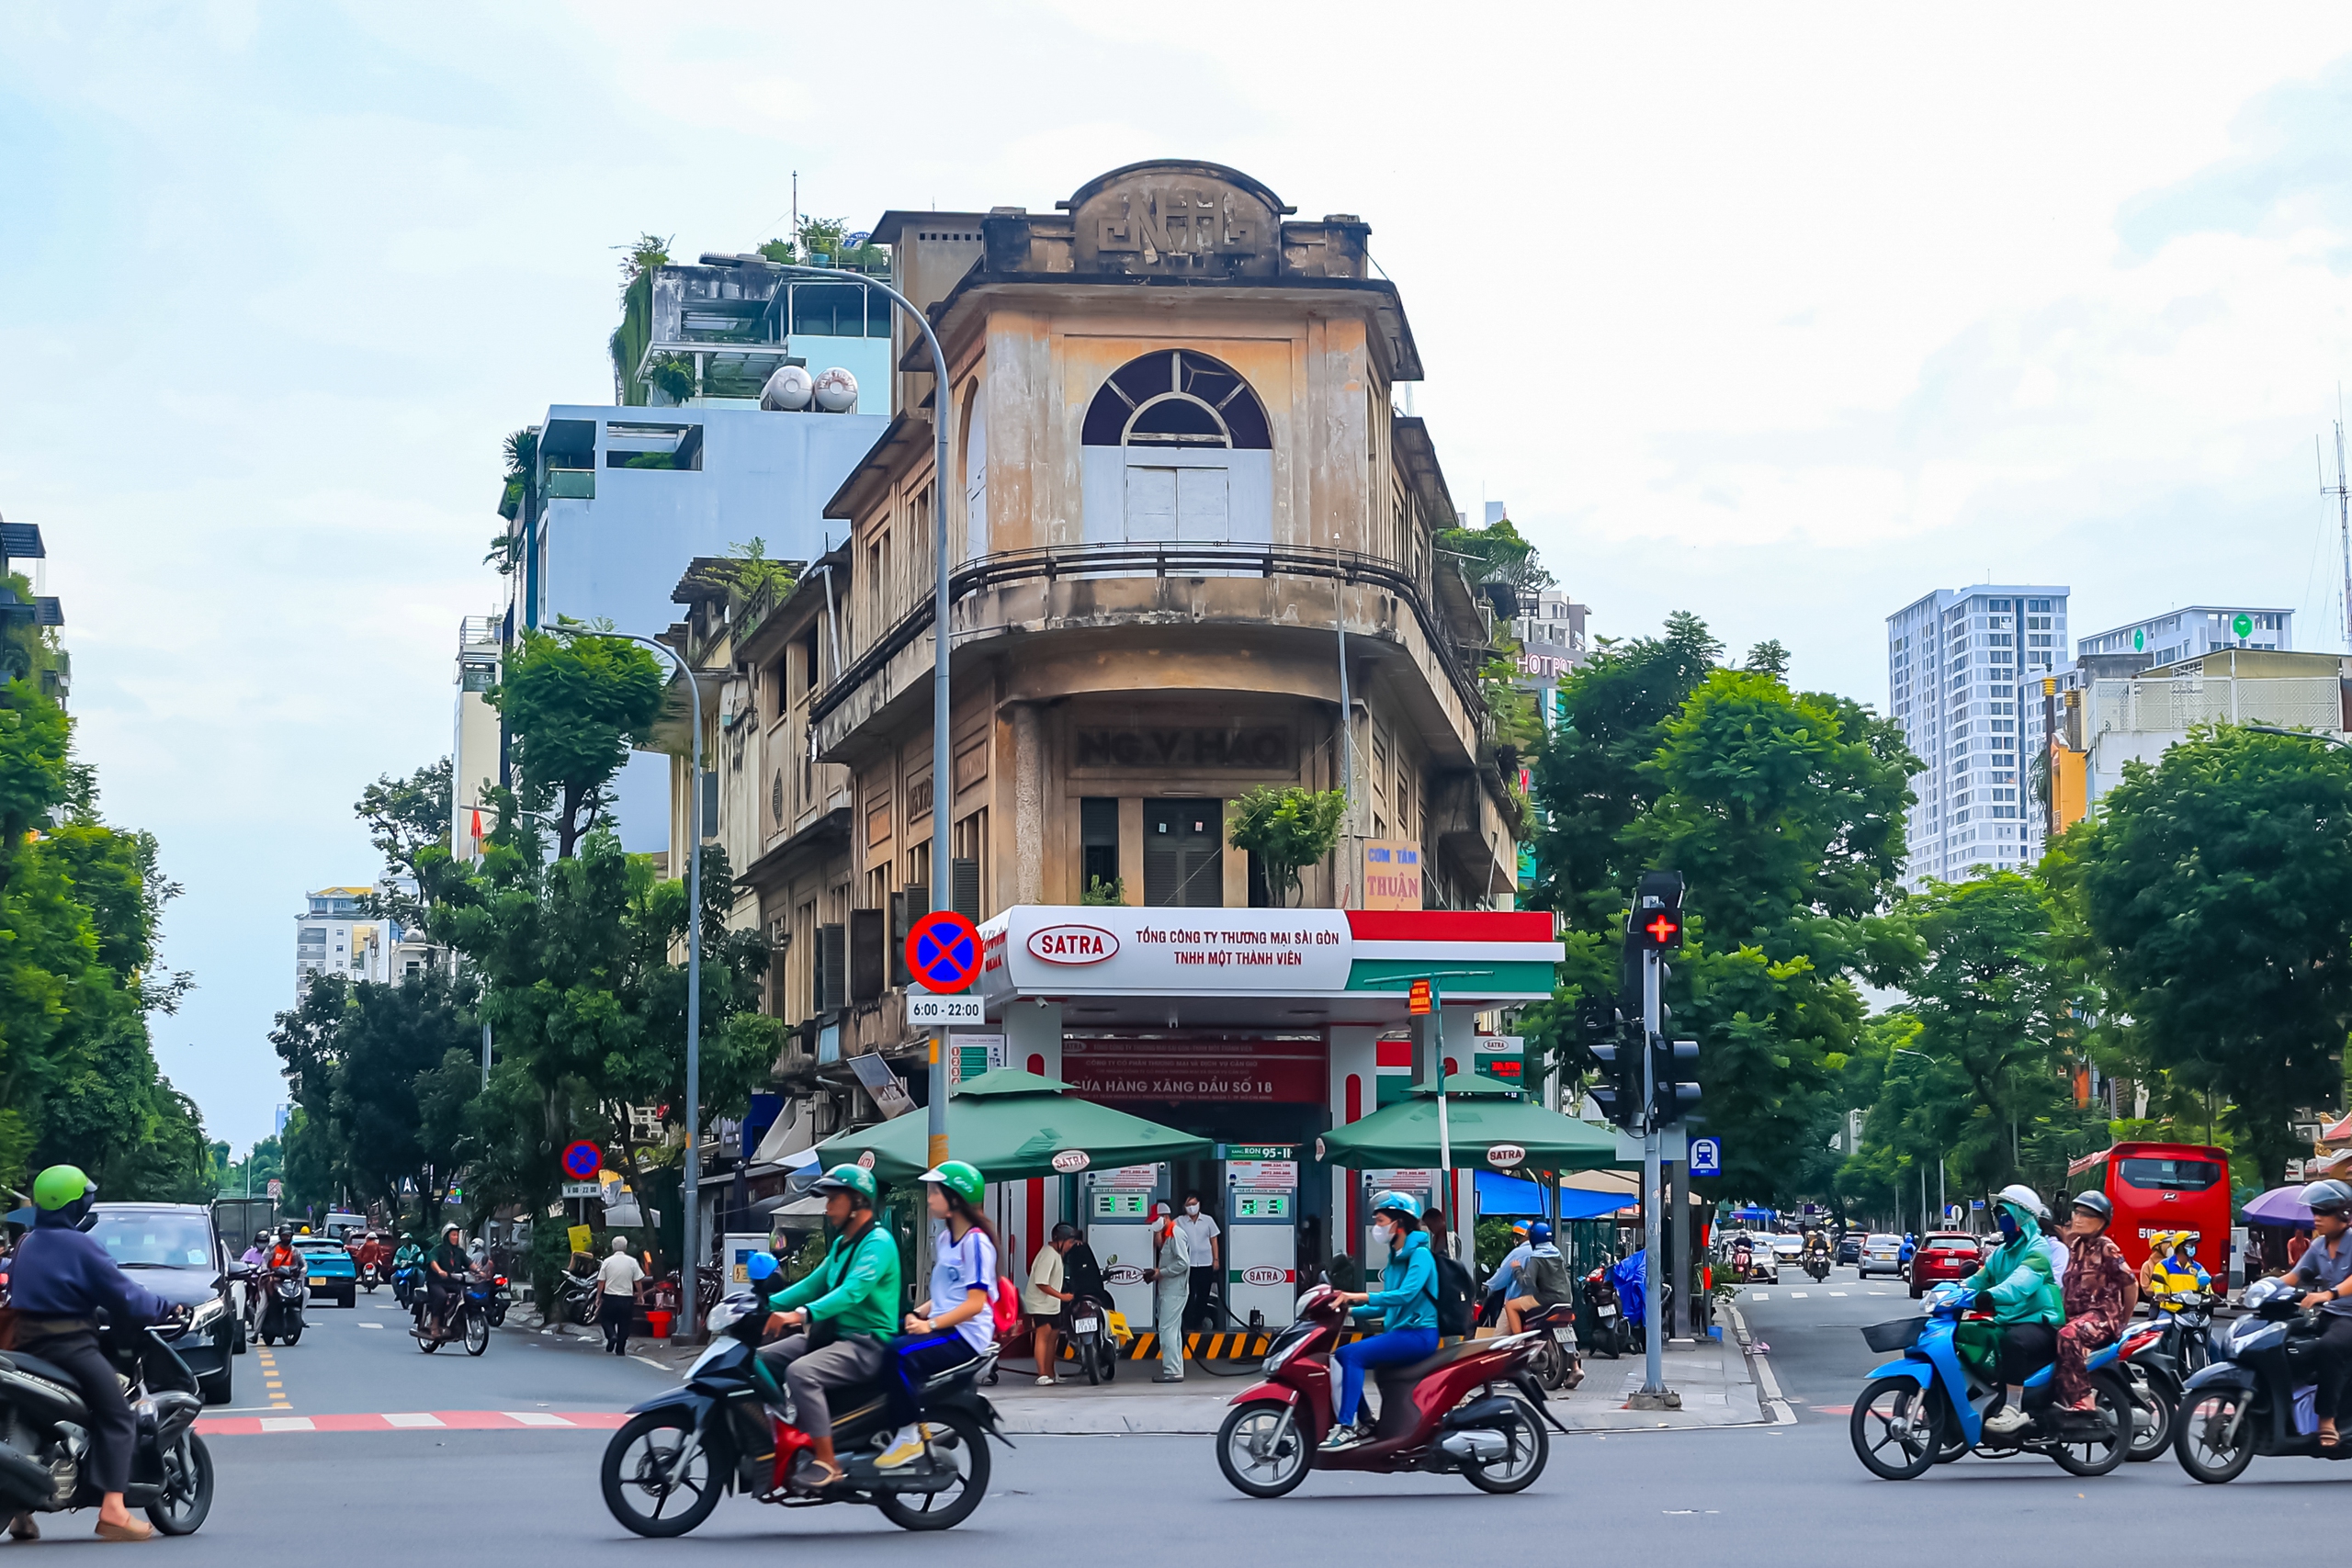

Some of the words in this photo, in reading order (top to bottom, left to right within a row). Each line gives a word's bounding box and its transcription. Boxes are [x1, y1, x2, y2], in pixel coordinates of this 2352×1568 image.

[1367, 872, 1418, 902] THUẬN
[1041, 935, 1104, 954] SATRA
[1170, 929, 1200, 944] CÔNG
[1204, 931, 1218, 944] TY
[1221, 931, 1266, 944] THƯƠNG
[1271, 932, 1291, 947] MẠI
[1295, 929, 1312, 945] SÀI
[1316, 930, 1339, 945] GÒN
[1174, 951, 1204, 964] TNHH
[1208, 949, 1233, 967] MỘT
[1235, 949, 1273, 964] THÀNH
[1276, 950, 1302, 965] VIÊN
[913, 1003, 938, 1016] 6:00
[948, 1004, 979, 1016] 22:00
[1106, 1077, 1148, 1092] HÀNG
[1153, 1078, 1194, 1092] XĂNG
[1199, 1075, 1228, 1092] DẦU
[1233, 1076, 1251, 1092] SỐ
[1257, 1082, 1272, 1093] 18
[1054, 1155, 1087, 1168] SATRA
[1490, 1150, 1522, 1161] SATRA
[1250, 1271, 1278, 1281] SATRA
